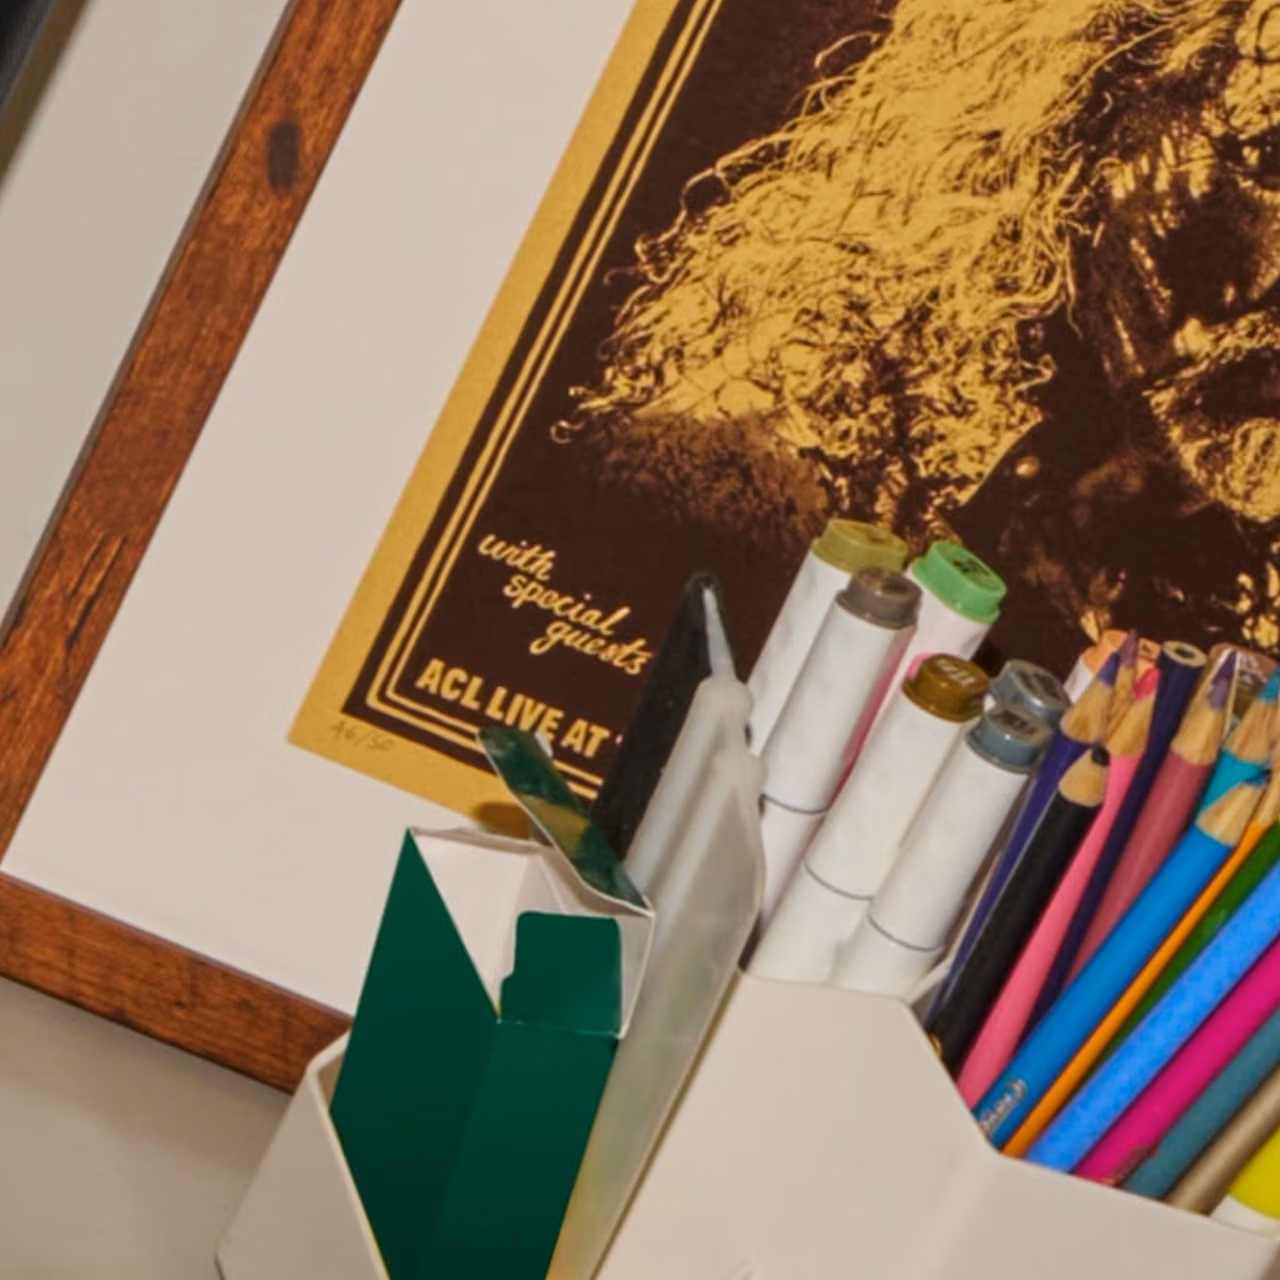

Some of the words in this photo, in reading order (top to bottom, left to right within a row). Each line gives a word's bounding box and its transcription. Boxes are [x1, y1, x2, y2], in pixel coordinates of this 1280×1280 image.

[477, 534, 557, 581] with
[502, 573, 631, 637] special
[529, 620, 654, 676] guests
[415, 658, 482, 712] ACL
[486, 684, 566, 742] LIVE
[559, 717, 613, 758] AT
